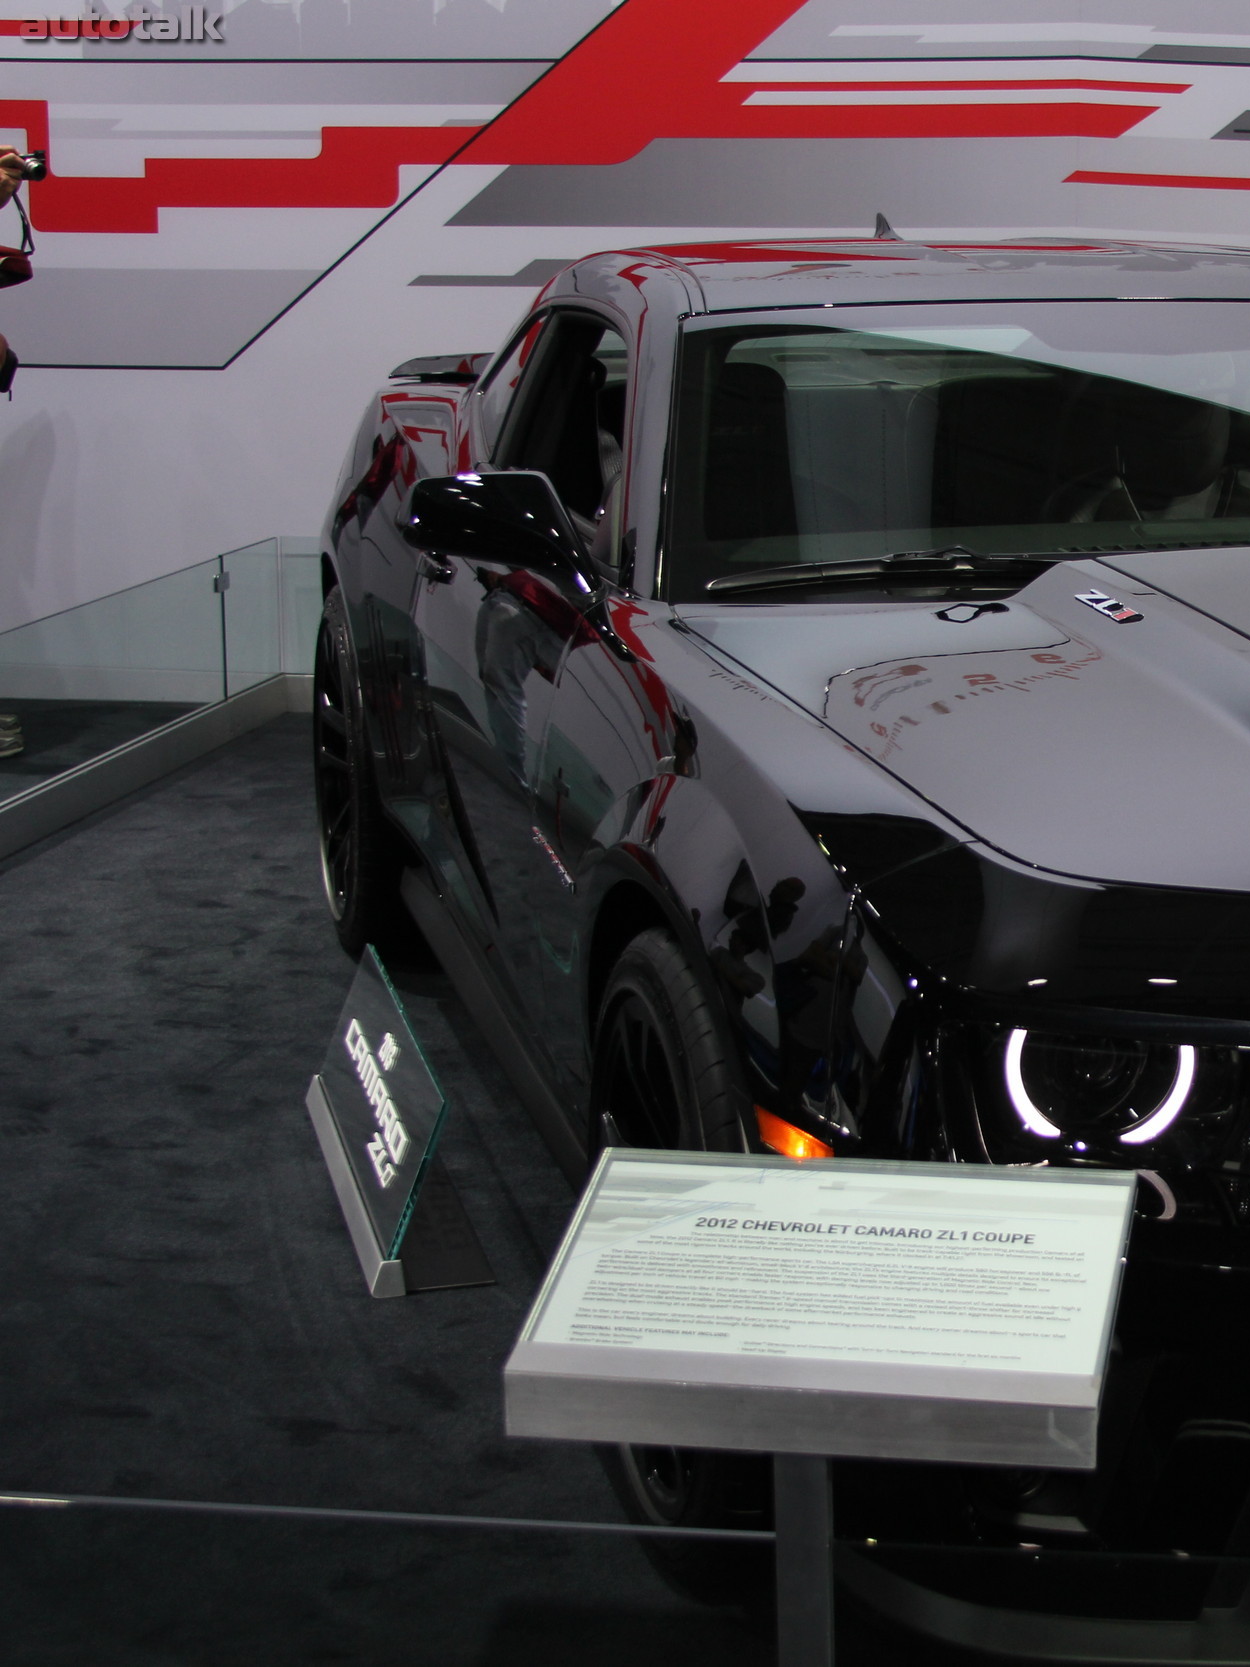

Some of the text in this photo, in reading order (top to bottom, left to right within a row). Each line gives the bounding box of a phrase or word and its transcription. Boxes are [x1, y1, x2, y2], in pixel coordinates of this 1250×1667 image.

[345, 1018, 409, 1165] CAMARO
[695, 1216, 738, 1230] 2012
[742, 1219, 851, 1236] CHEVROLET
[854, 1225, 932, 1239] CAMARO
[936, 1229, 969, 1241] ZL1
[972, 1231, 1036, 1245] COUPE
